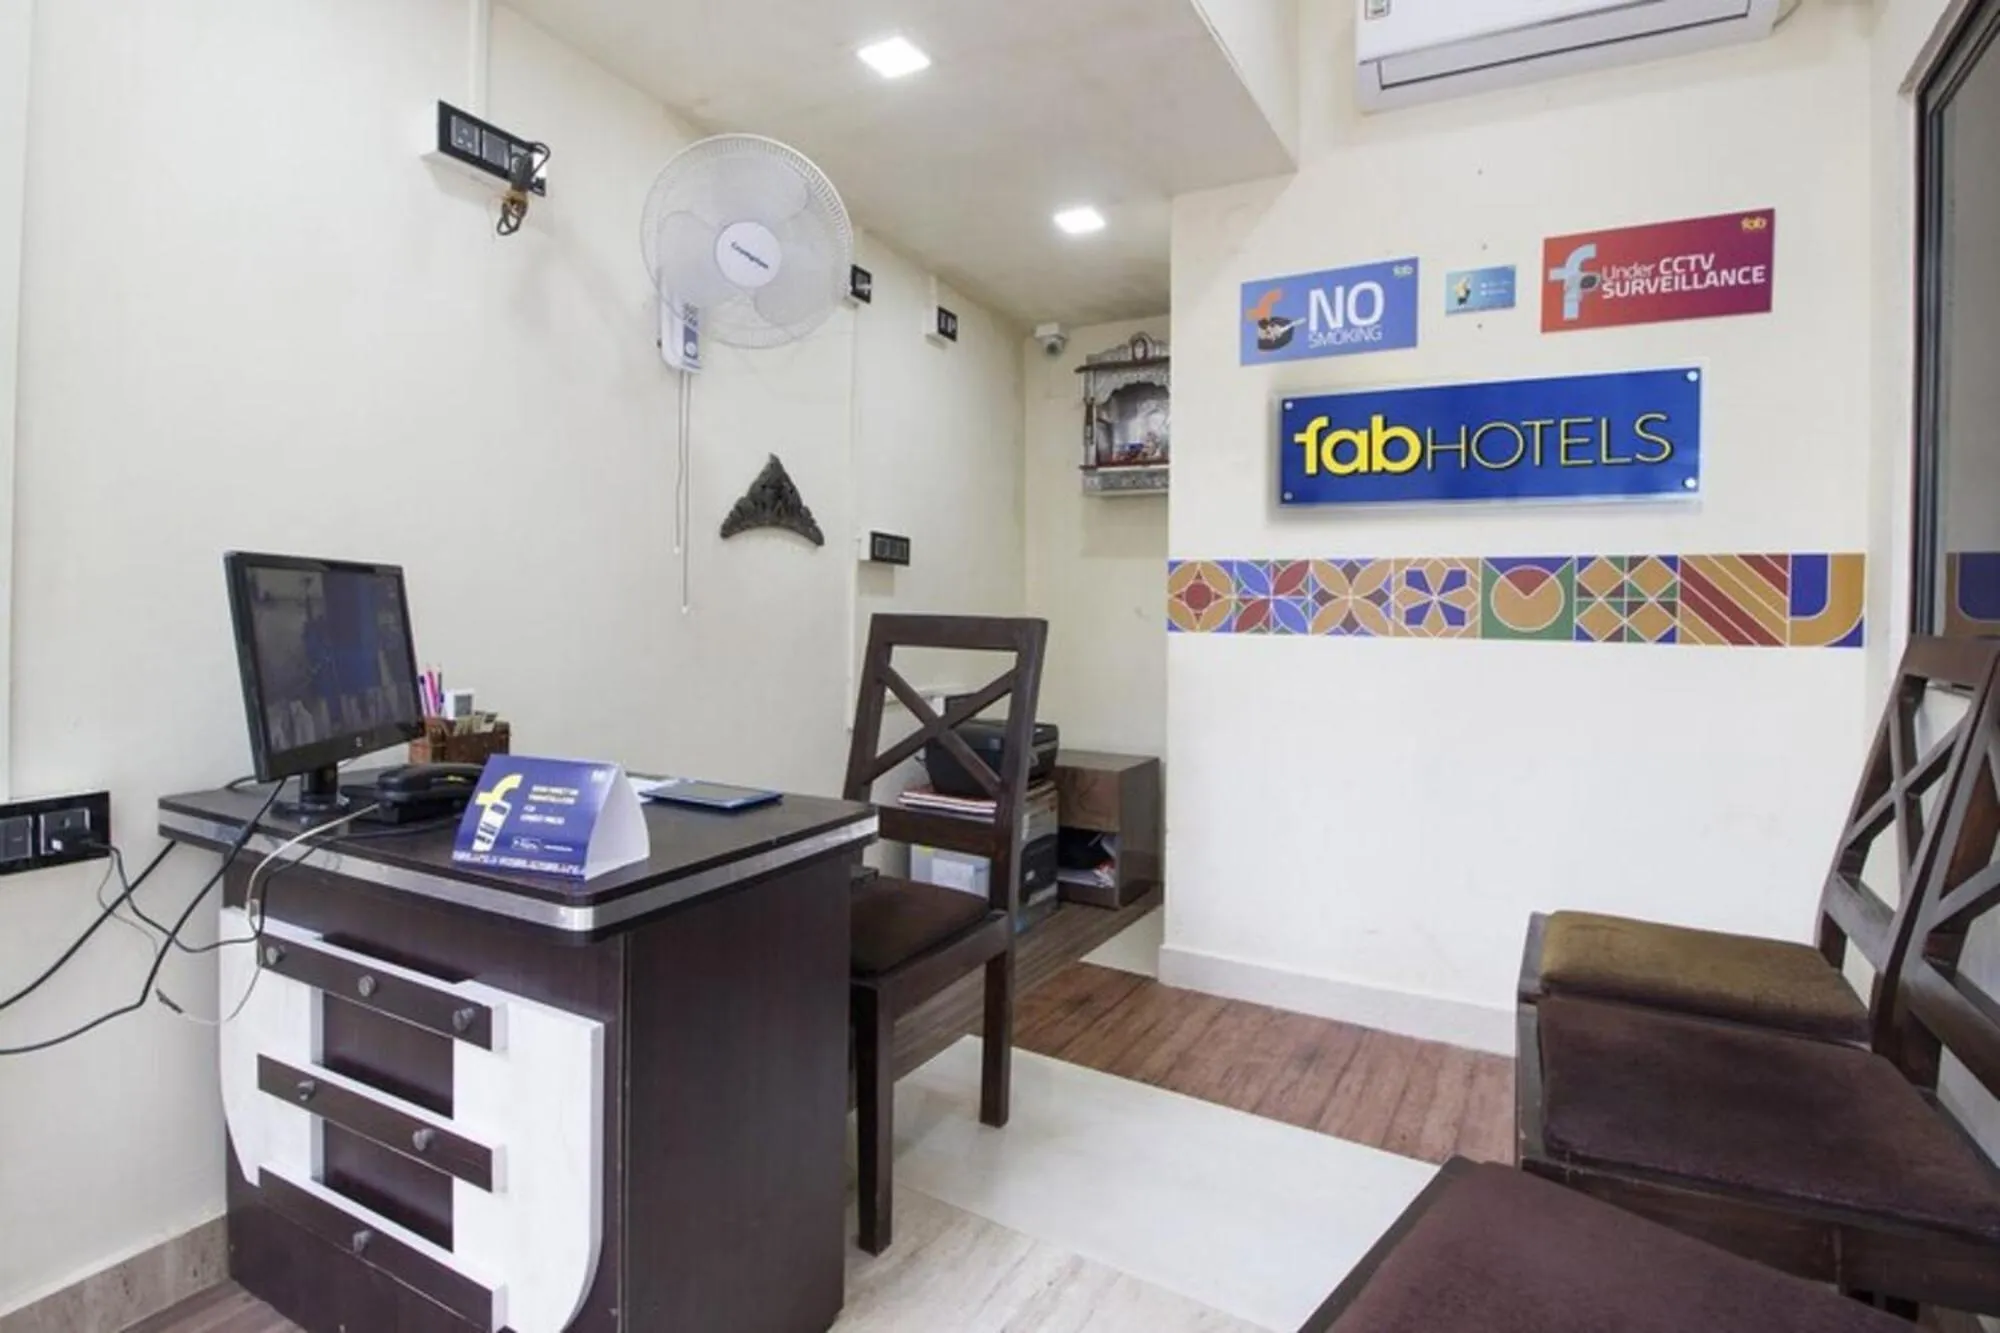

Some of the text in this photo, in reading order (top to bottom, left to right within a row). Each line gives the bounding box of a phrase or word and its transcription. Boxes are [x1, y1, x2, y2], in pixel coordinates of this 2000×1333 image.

[1601, 253, 1716, 281] Under CCTV
[1602, 265, 1767, 299] SURVEILLANCE
[1308, 280, 1385, 332] NO
[1308, 324, 1384, 349] SMOKING
[1293, 412, 1673, 476] fabHOTELS
